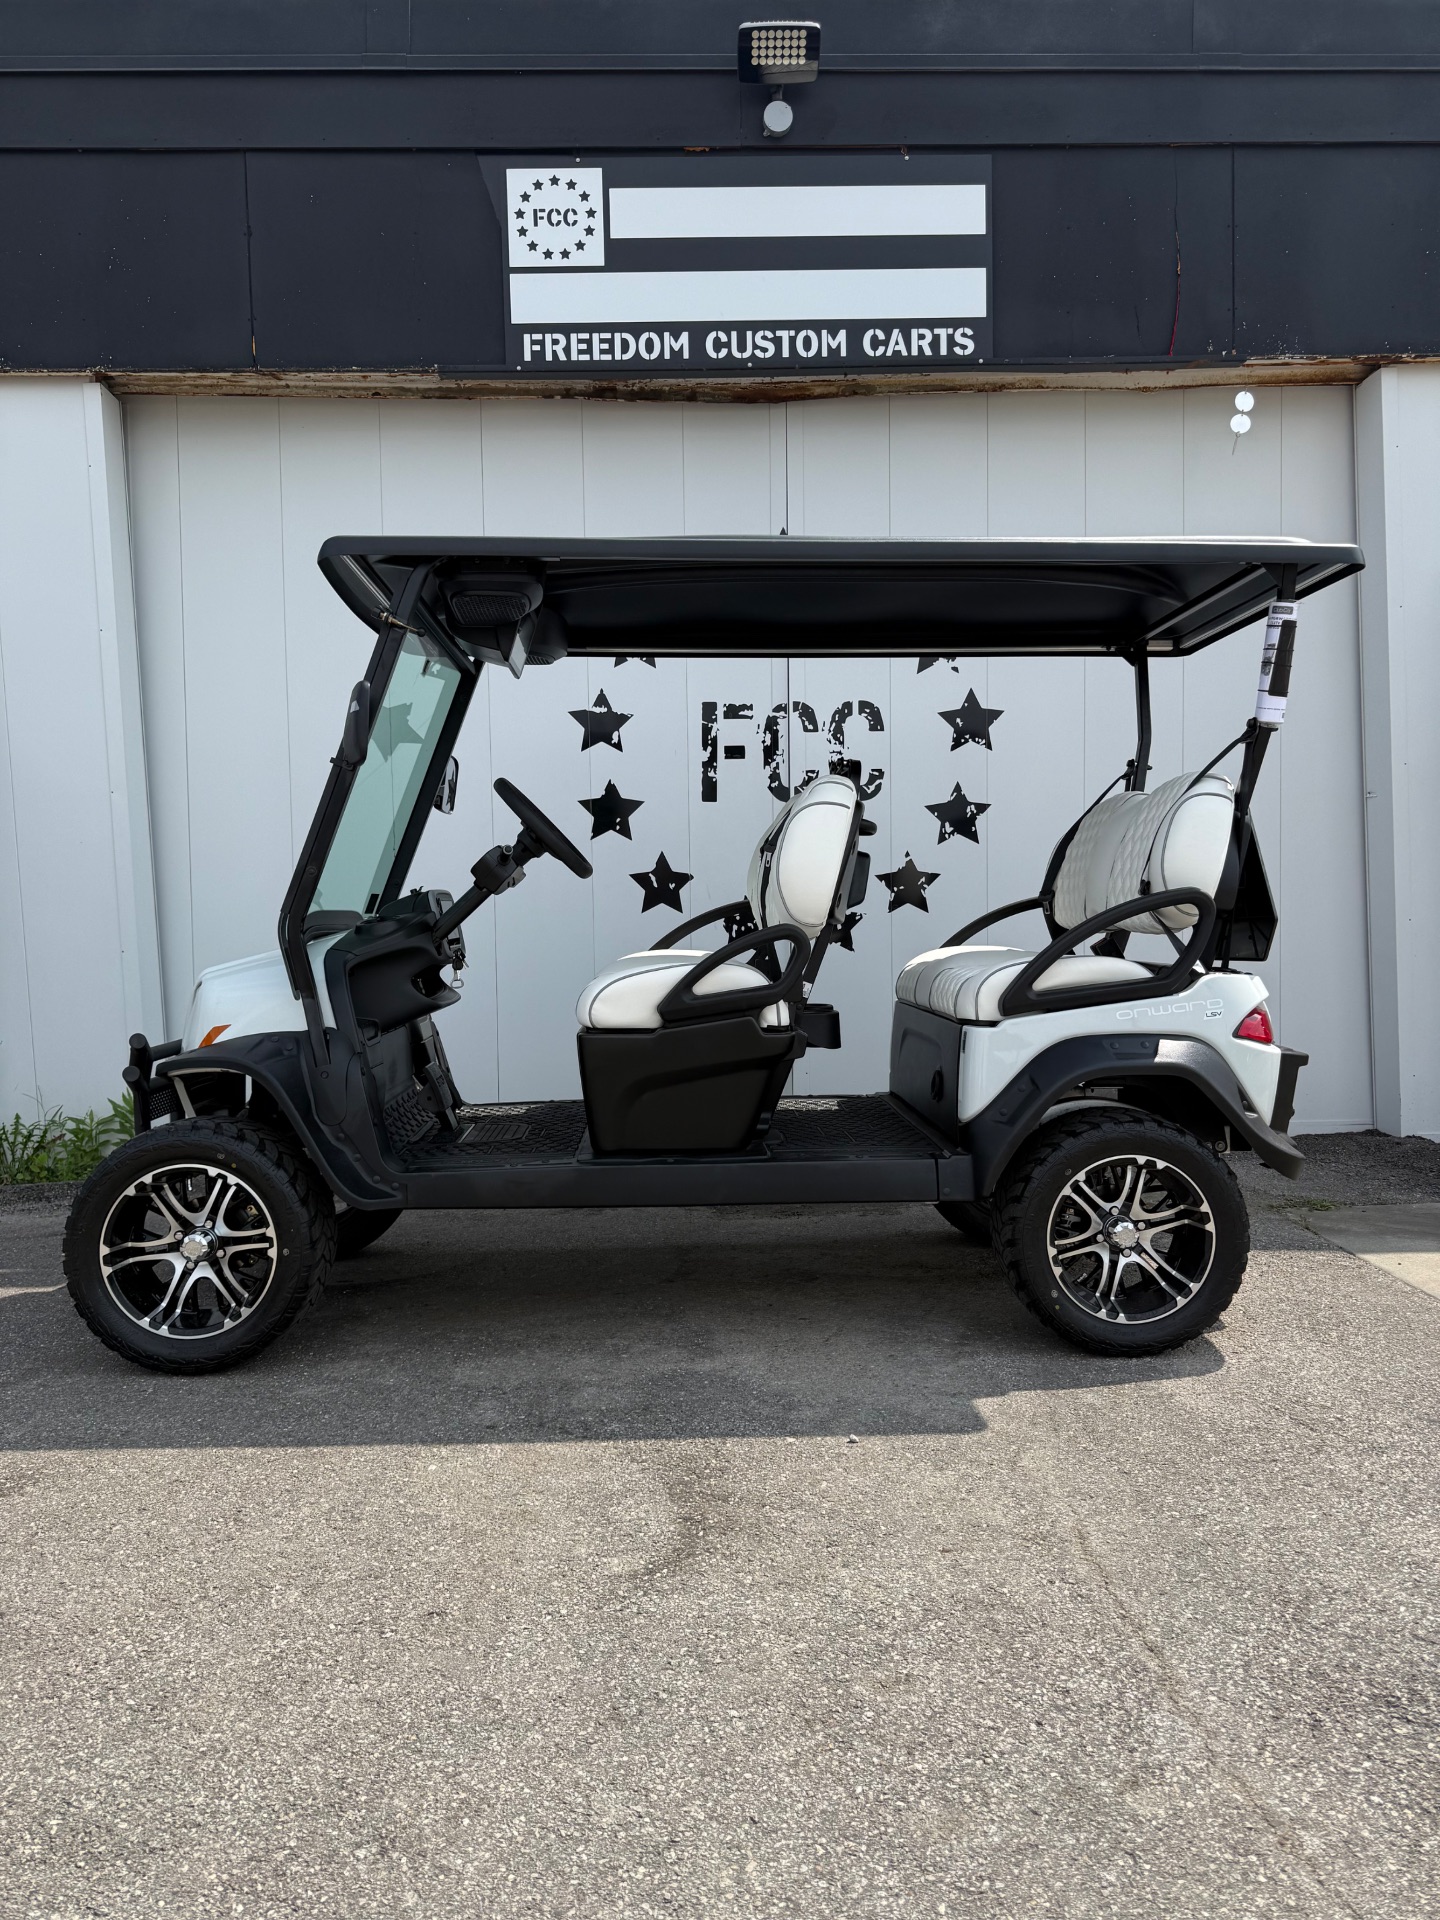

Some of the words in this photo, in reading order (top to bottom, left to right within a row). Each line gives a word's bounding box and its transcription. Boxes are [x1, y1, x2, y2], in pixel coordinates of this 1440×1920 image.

[532, 208, 579, 228] FCC
[523, 331, 690, 361] FREEDOM
[705, 329, 847, 359] CUSTOM
[862, 327, 975, 357] CARTS
[701, 700, 884, 803] FCC
